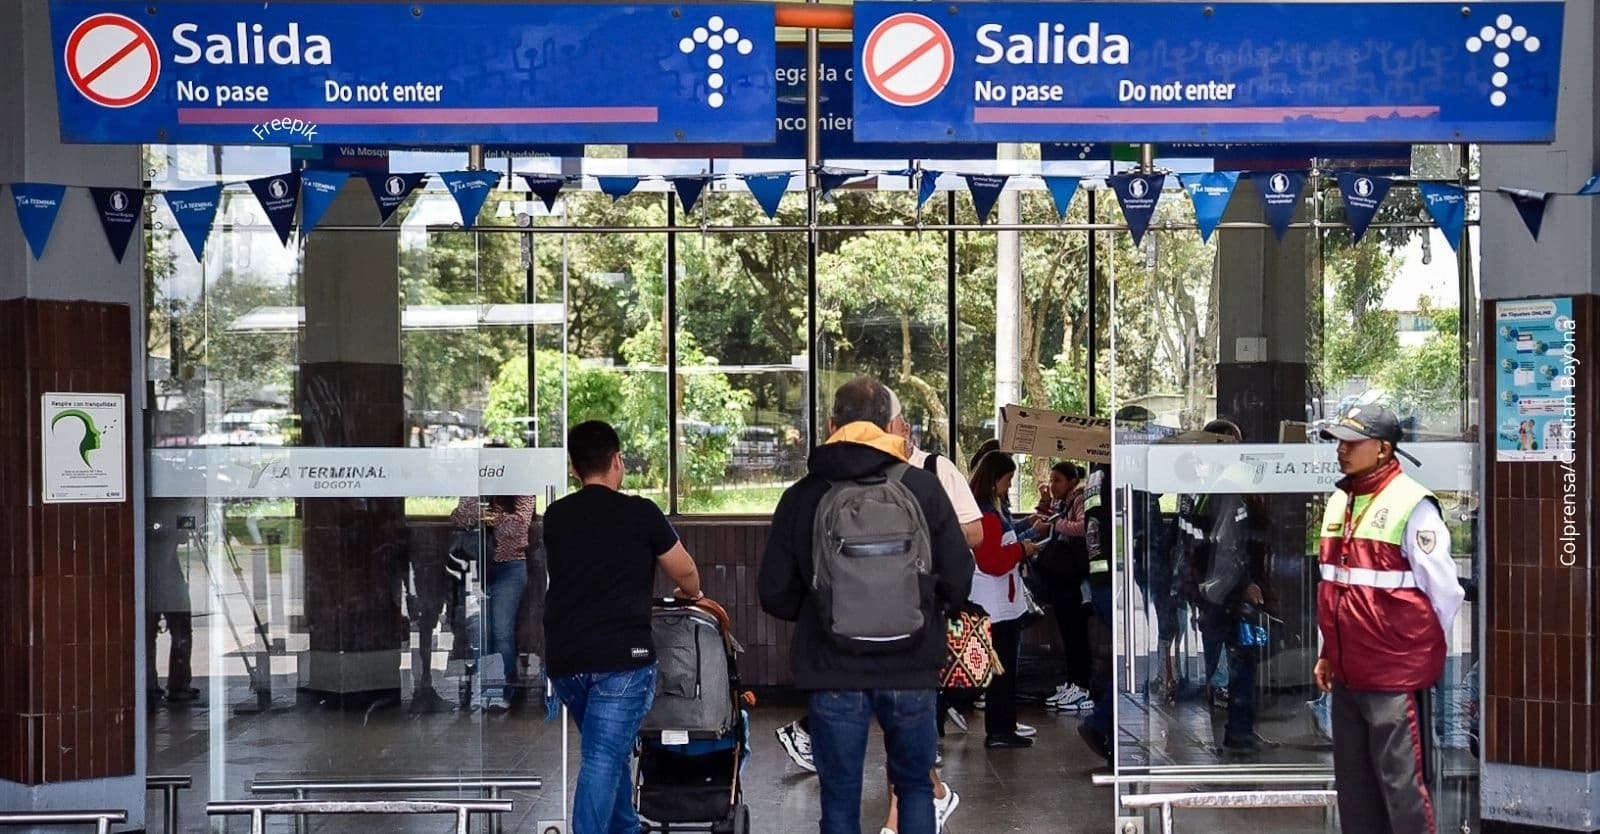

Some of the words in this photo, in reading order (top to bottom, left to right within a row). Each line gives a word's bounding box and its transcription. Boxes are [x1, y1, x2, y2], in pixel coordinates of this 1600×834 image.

[171, 21, 332, 65] Salida
[975, 21, 1130, 65] Salida
[176, 80, 209, 102] No
[216, 84, 269, 106] pase
[325, 80, 352, 102] Do
[356, 81, 389, 102] not
[393, 81, 443, 102] enter
[975, 80, 1006, 101] No
[1011, 84, 1063, 106] pase
[1119, 80, 1146, 102] Do
[1150, 81, 1182, 101] not
[1185, 81, 1236, 101] enter
[298, 466, 386, 479] TERMINAL
[1275, 462, 1295, 474] LA
